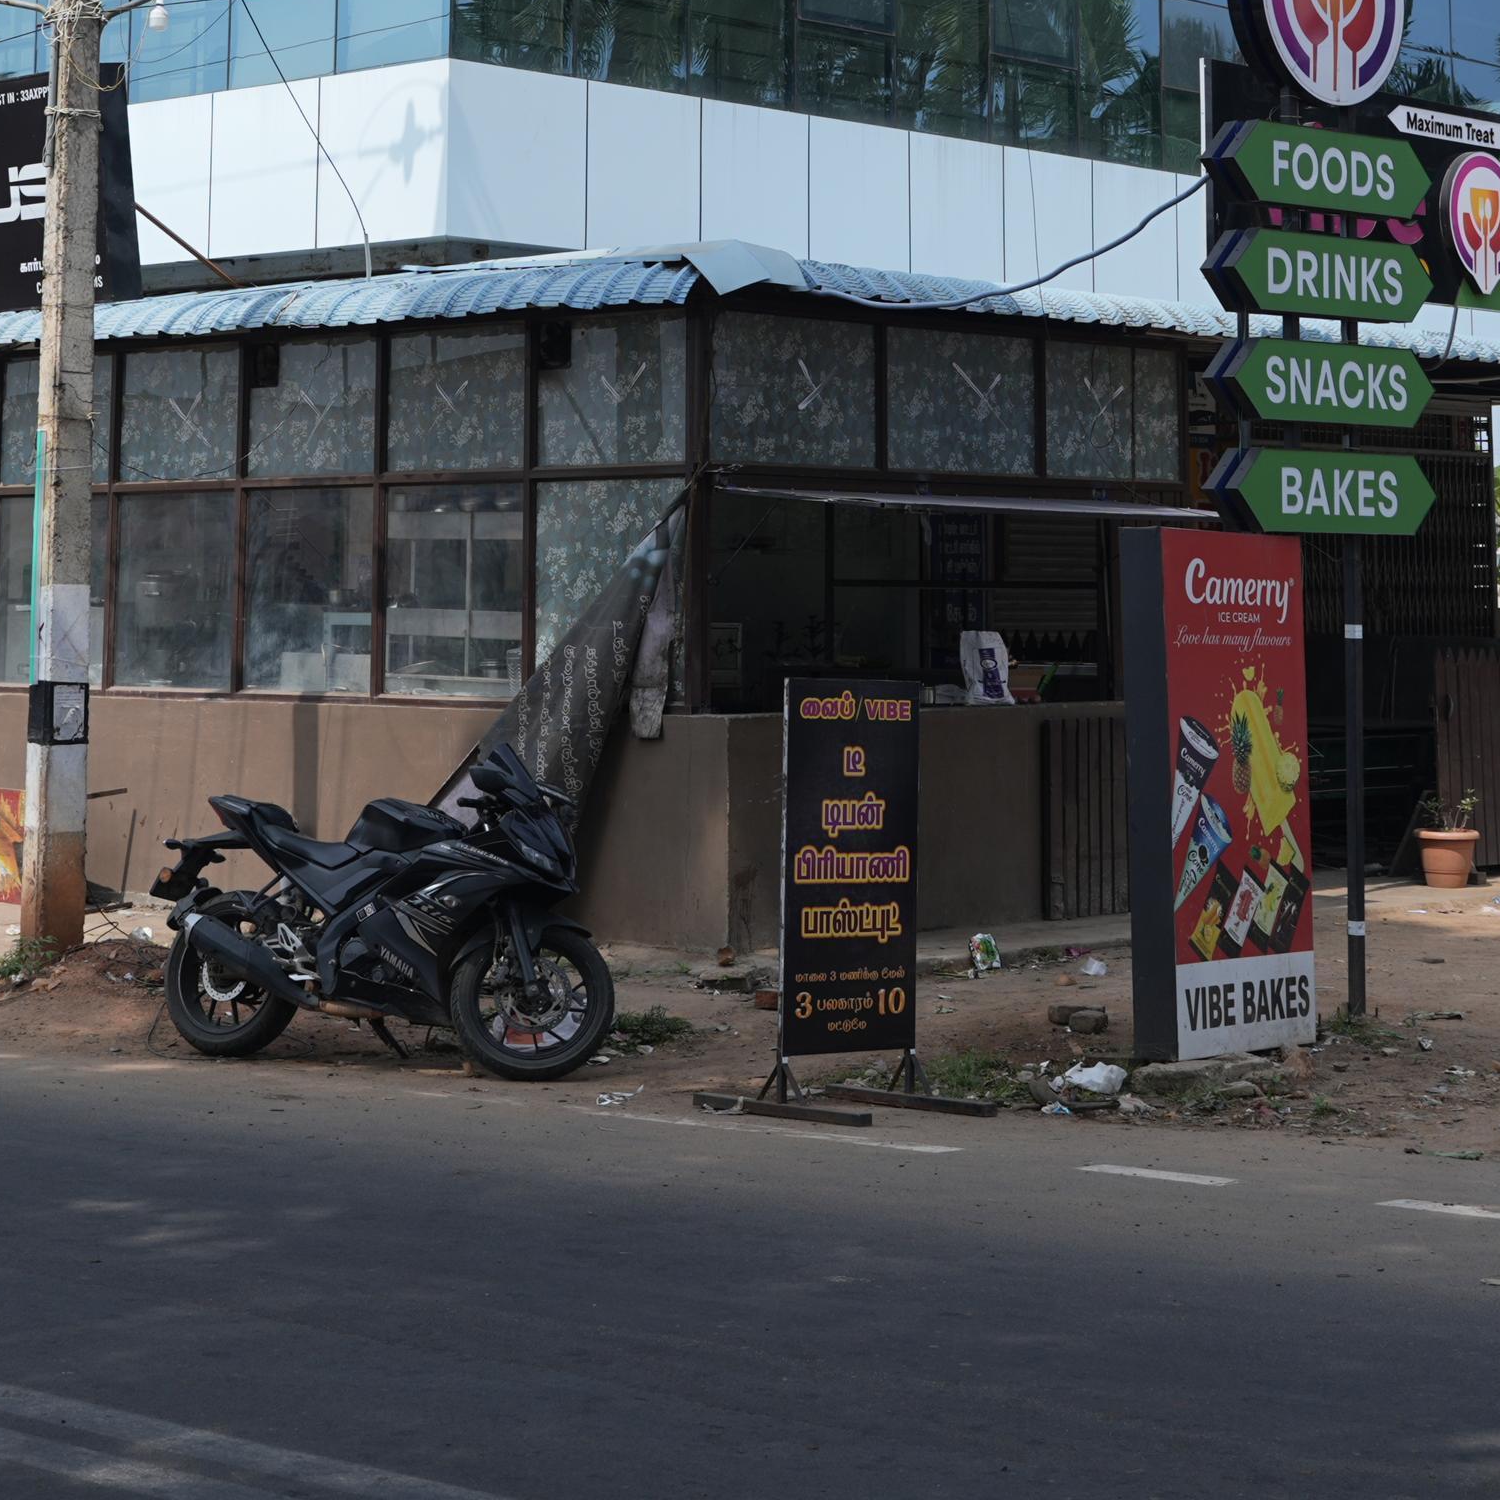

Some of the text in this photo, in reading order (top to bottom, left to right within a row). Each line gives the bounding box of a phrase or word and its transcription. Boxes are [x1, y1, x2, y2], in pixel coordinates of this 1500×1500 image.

[1406, 111, 1495, 144] Maximum Treat
[1273, 139, 1395, 200] FOODS
[1267, 246, 1403, 306] DRINKS
[1265, 355, 1408, 411] SNACKS
[1280, 466, 1399, 518] BAKES
[1185, 558, 1289, 624] Camerry
[1218, 612, 1260, 623] ICE CREAM
[1173, 625, 1291, 652] Love has many flavours
[864, 699, 911, 721] VIBE
[380, 945, 414, 979] YAMAHA
[829, 970, 837, 981] 3
[795, 991, 813, 1019] 3
[877, 987, 906, 1016] 10
[1185, 974, 1310, 1032] VIBE BAKES
